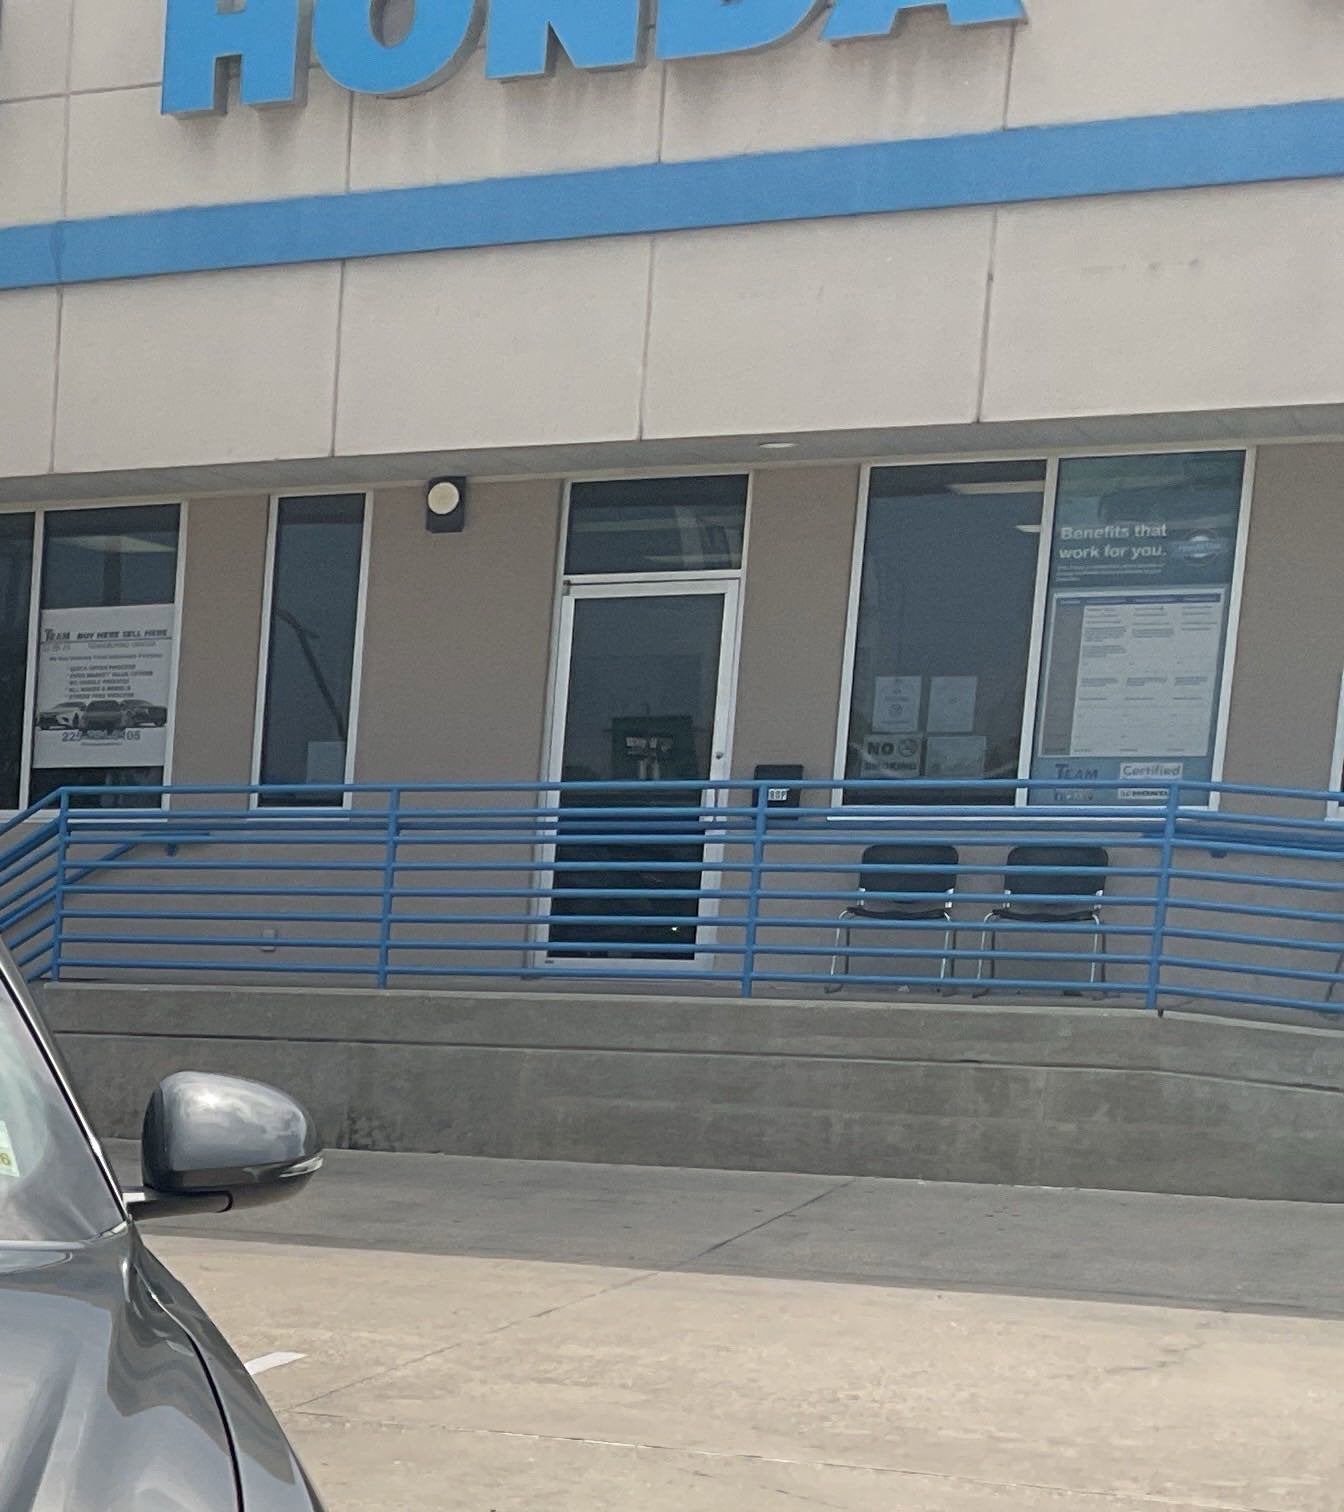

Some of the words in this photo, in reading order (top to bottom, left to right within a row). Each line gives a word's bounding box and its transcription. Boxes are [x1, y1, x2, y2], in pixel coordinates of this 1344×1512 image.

[160, 0, 1026, 116] HON
[1061, 526, 1130, 541] Benefits
[1134, 523, 1168, 538] that
[1059, 545, 1102, 559] work
[1104, 544, 1127, 558] for
[1132, 545, 1167, 561] you.
[867, 742, 895, 755] NO
[1122, 764, 1181, 777] Certified
